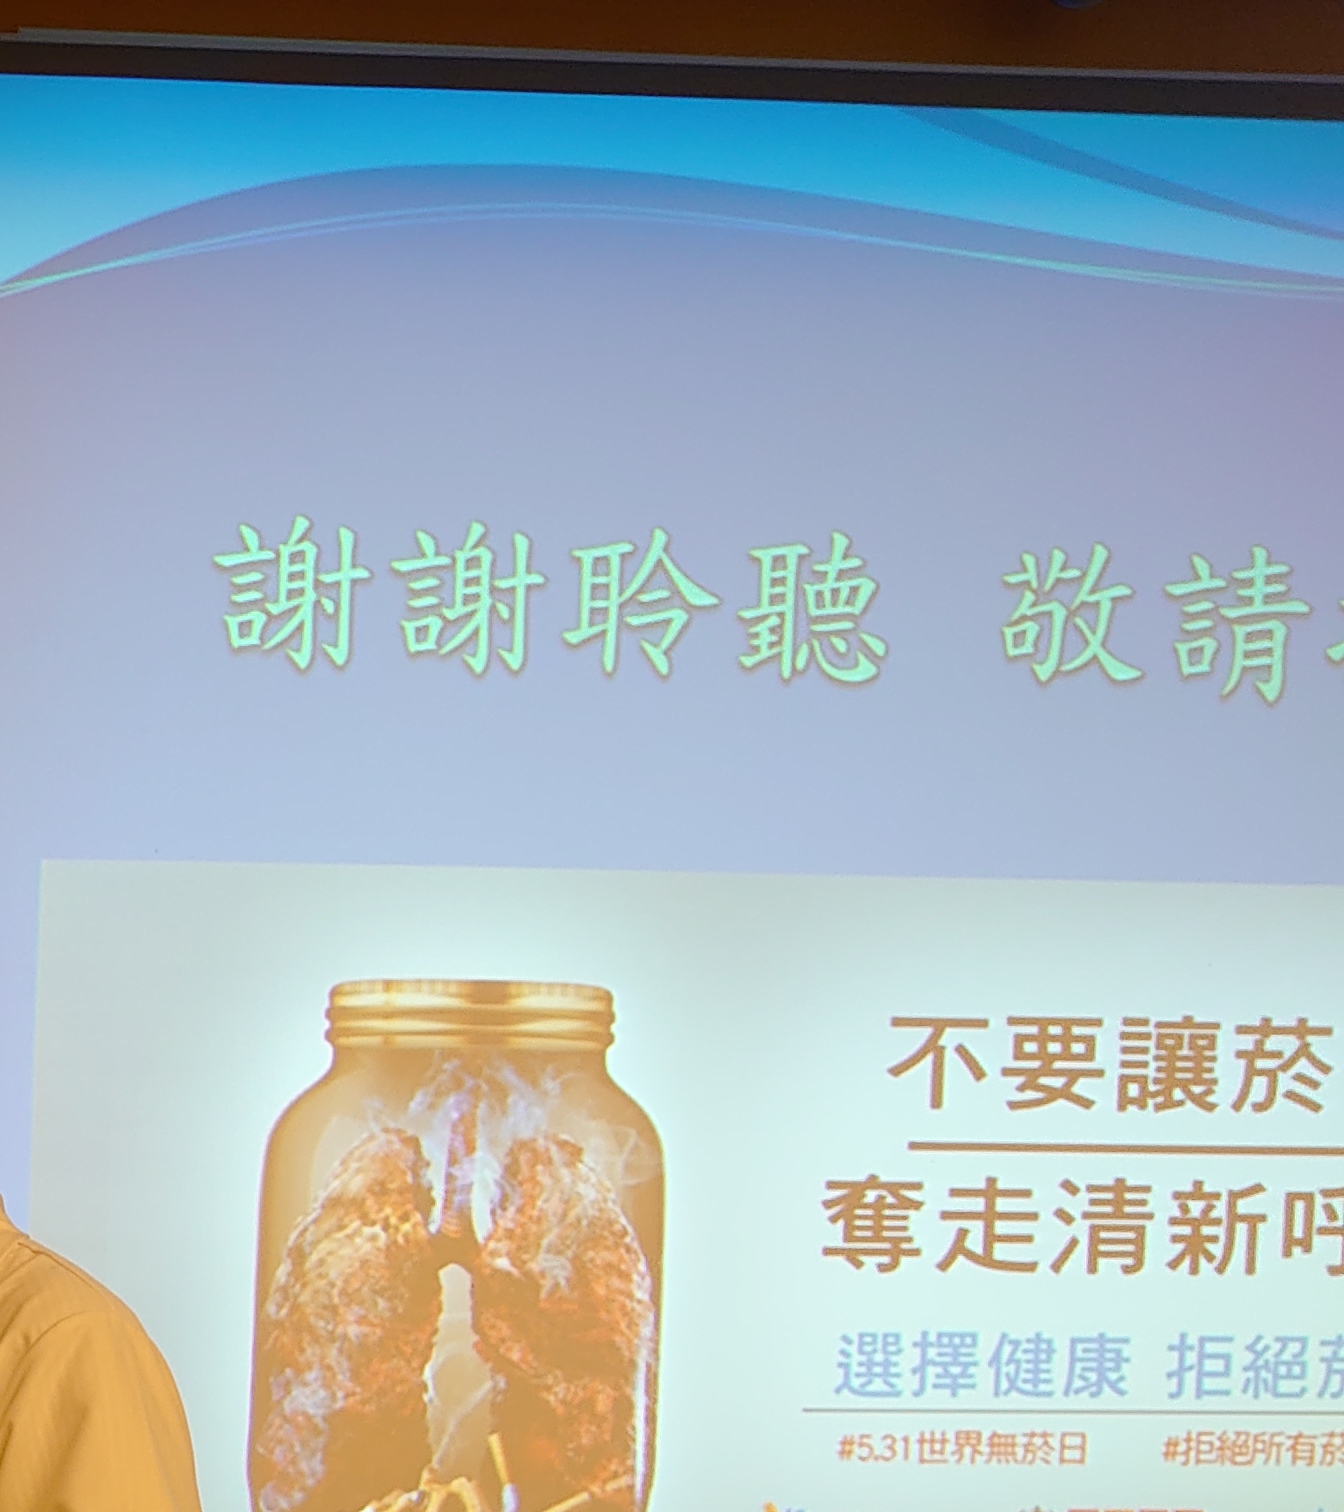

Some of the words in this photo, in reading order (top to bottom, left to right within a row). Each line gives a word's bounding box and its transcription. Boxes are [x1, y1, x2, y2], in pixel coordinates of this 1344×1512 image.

[213, 514, 888, 684] 謝謝聆聽
[1001, 541, 1344, 703] 敬請
[886, 1014, 1334, 1114] 不要讓菸
[833, 1330, 1132, 1398] 選擇健康
[836, 1429, 1089, 1466] #5.31世界無菸日
